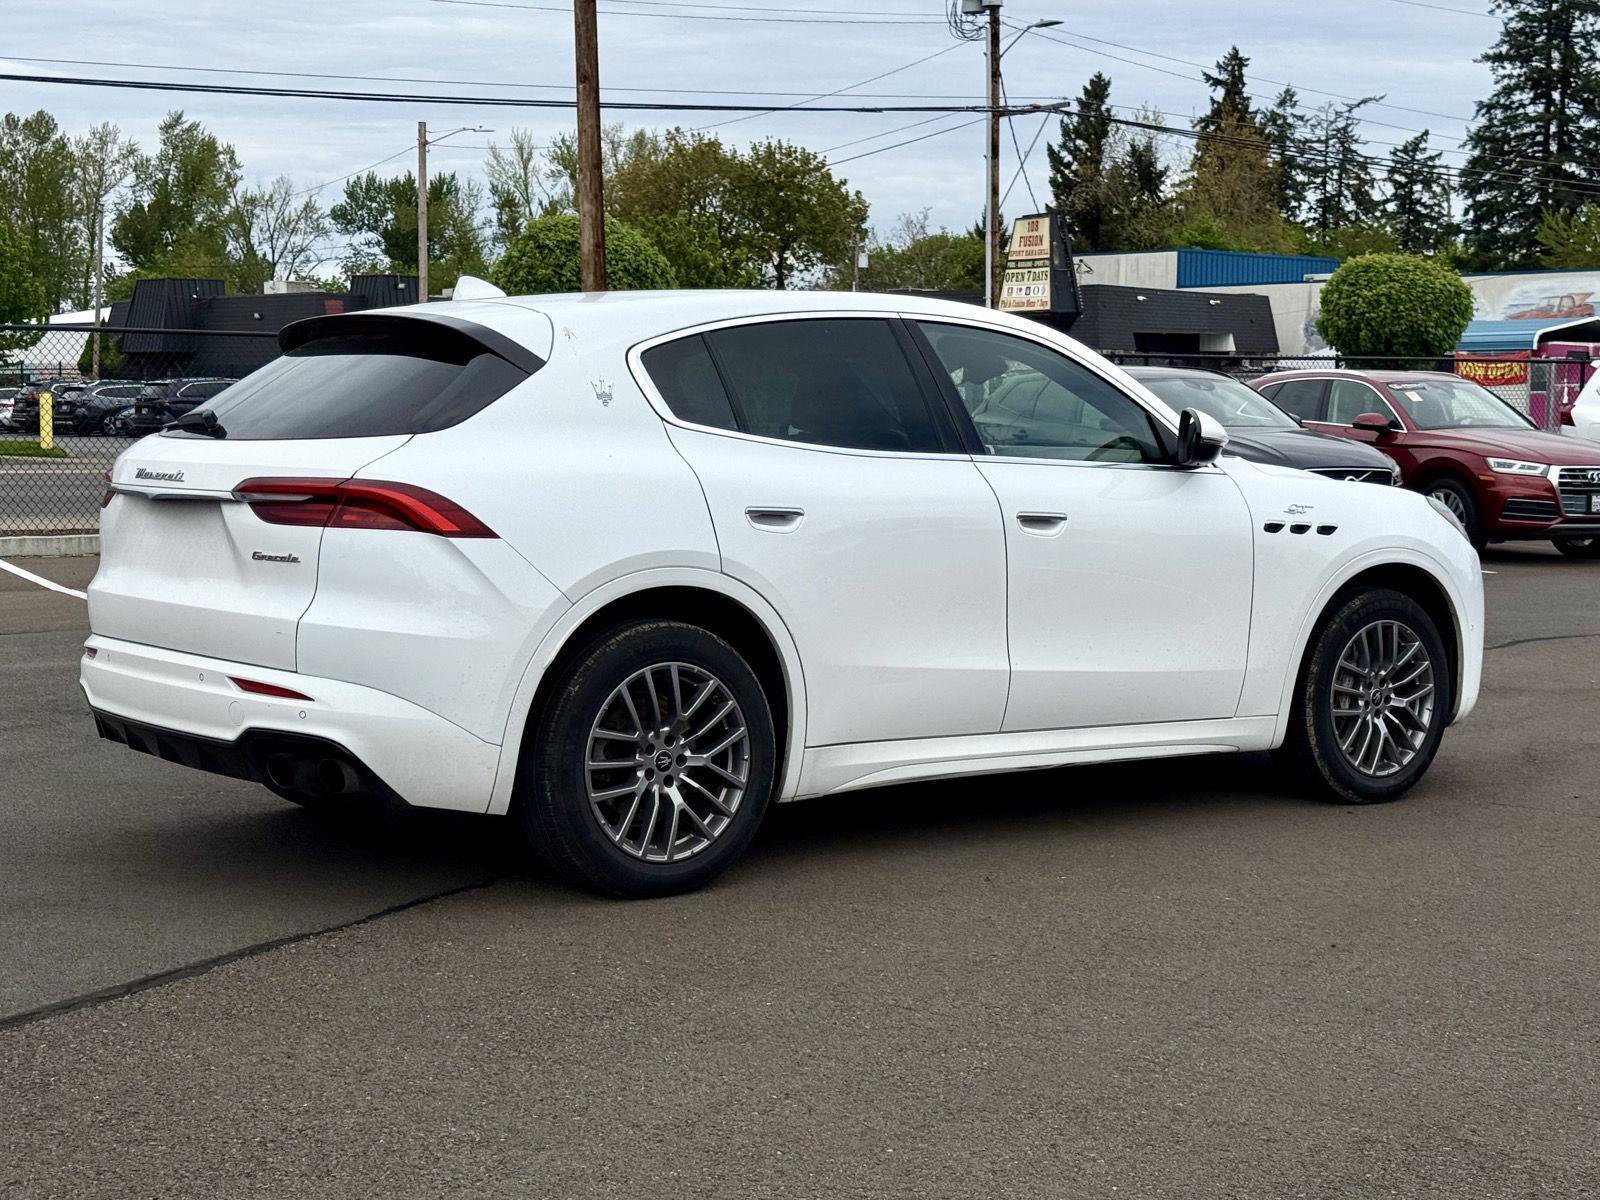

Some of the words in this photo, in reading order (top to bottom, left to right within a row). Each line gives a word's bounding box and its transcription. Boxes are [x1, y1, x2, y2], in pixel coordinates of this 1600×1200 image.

[1019, 235, 1043, 247] FUSION
[1005, 271, 1025, 283] OPEN
[1027, 270, 1032, 282] 7
[1032, 270, 1049, 282] DAYS
[135, 467, 186, 483] Maserati
